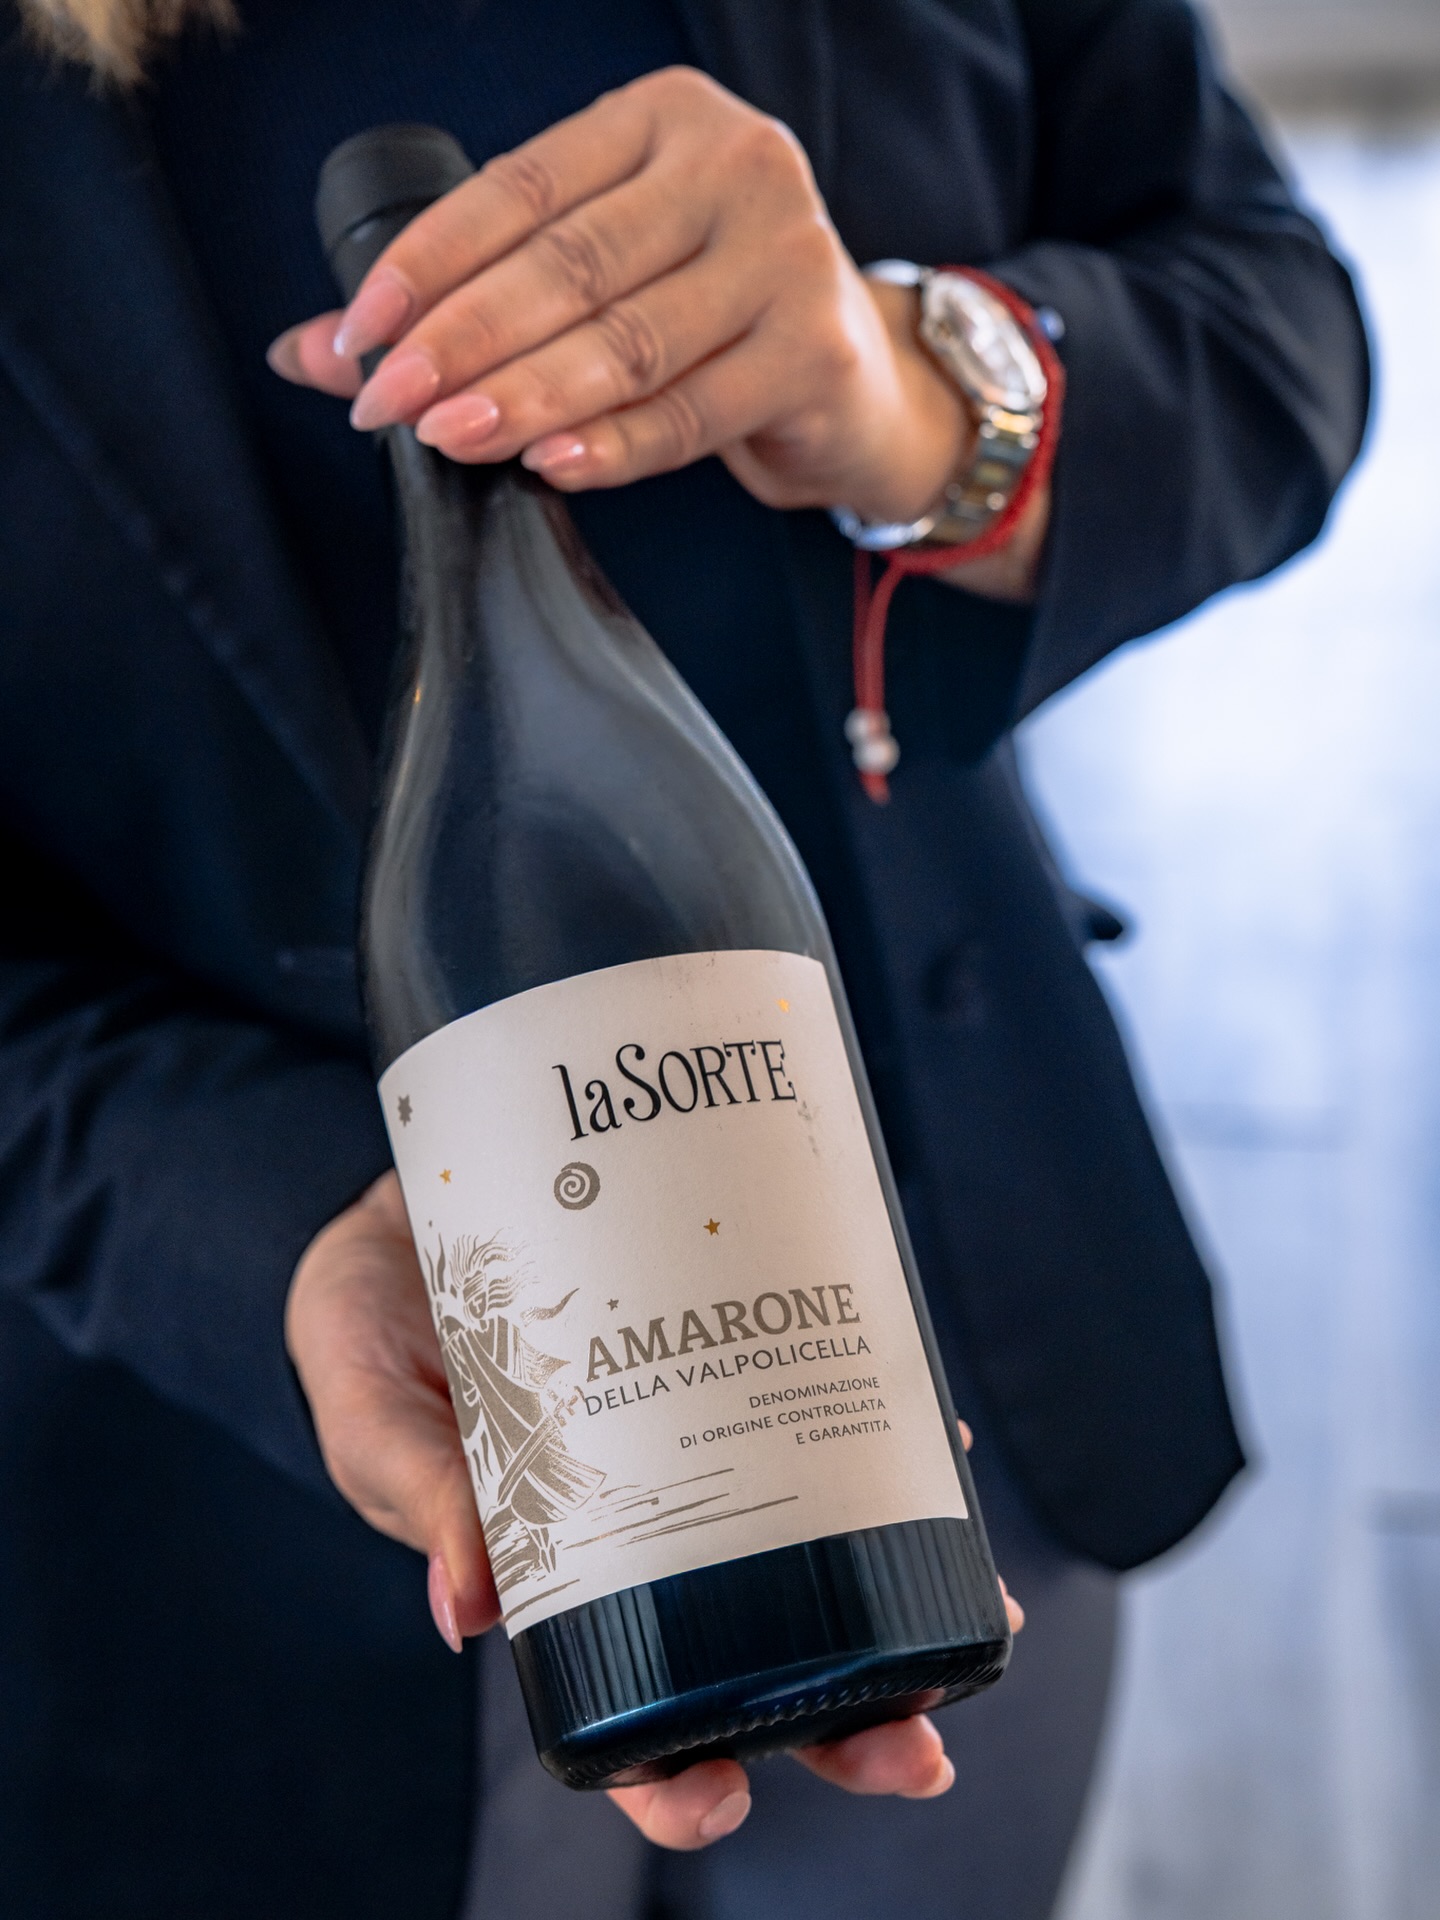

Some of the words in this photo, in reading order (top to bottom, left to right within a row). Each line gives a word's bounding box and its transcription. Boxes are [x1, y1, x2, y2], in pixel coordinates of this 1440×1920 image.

[586, 1283, 863, 1382] AMARONE
[585, 1374, 670, 1416] DELLA
[676, 1335, 872, 1387] VALPOLICELLA
[749, 1376, 880, 1409] DENOMINAZIONE
[680, 1434, 697, 1449] DI
[702, 1415, 774, 1443] ORIGINE
[777, 1398, 886, 1426] CONTROLLATA
[795, 1431, 806, 1445] E
[809, 1419, 892, 1443] GARANTITA
